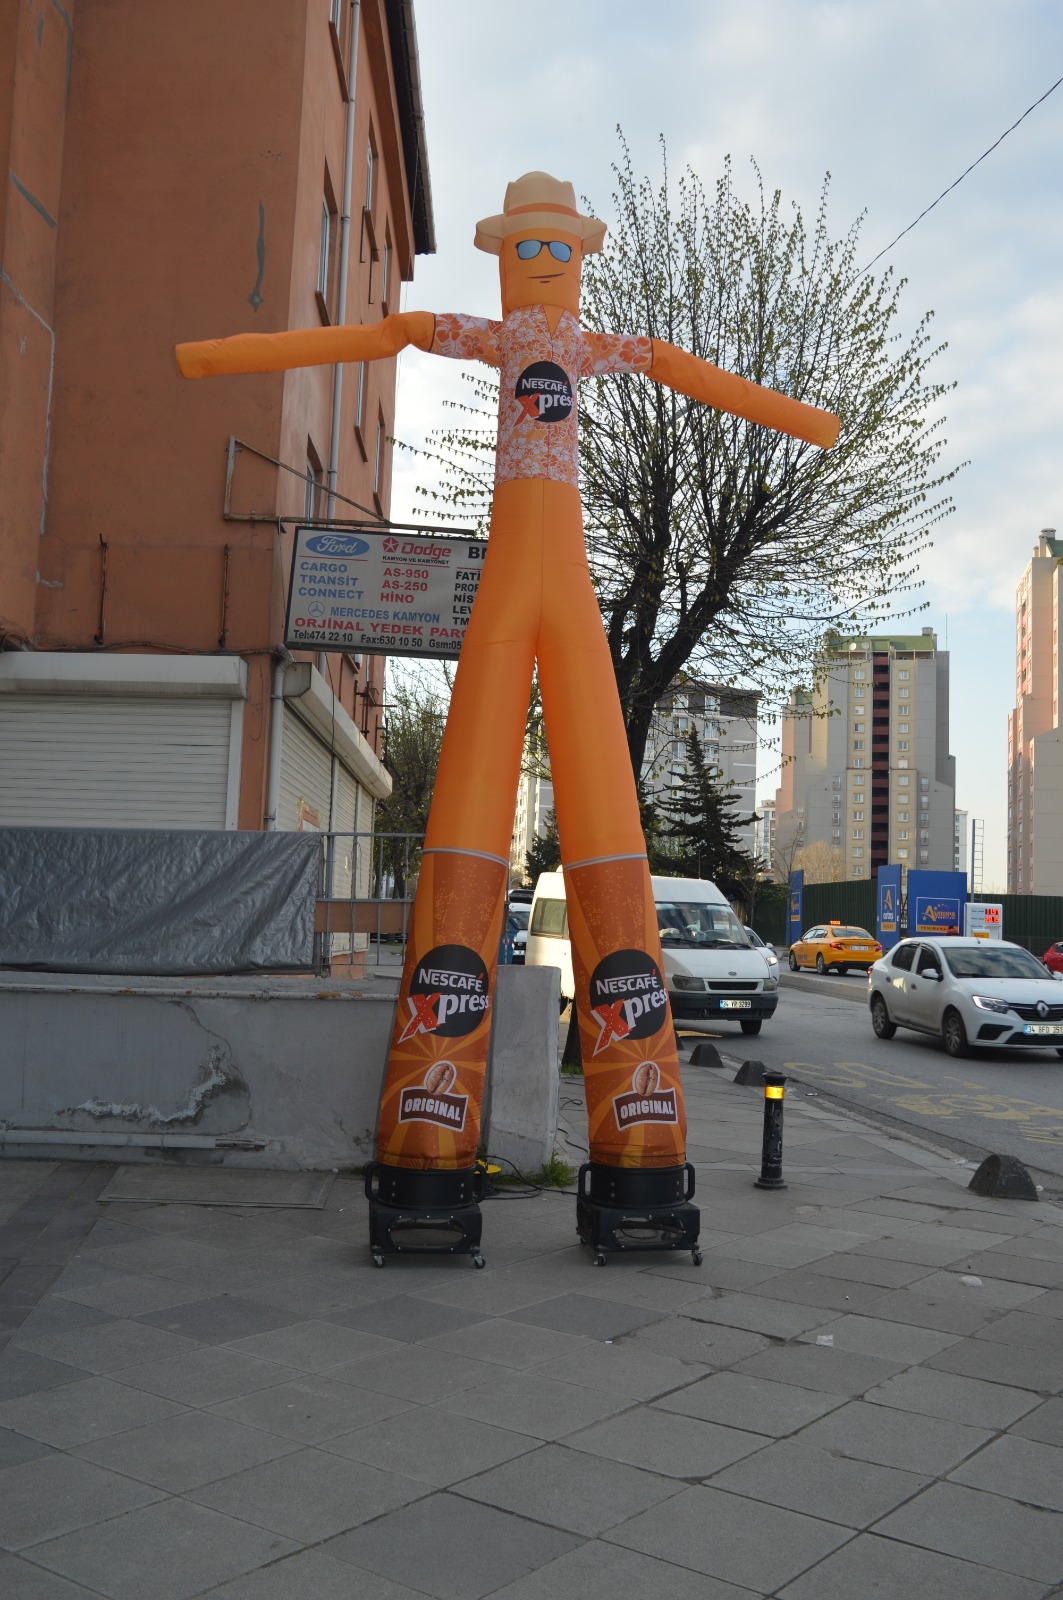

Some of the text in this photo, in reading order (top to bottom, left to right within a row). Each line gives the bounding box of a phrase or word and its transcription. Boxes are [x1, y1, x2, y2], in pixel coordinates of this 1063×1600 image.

[522, 378, 569, 393] NESCAFÉ
[317, 535, 356, 554] Ford
[402, 543, 451, 560] Dodge
[300, 562, 347, 573] CARGO
[383, 568, 429, 579] AS-950
[300, 574, 359, 586] TRANSİT
[382, 580, 428, 592] AS-250
[298, 587, 364, 600] CONNECT
[380, 592, 414, 604] HİNO
[331, 607, 440, 623] MERCEDES KAMYON
[295, 617, 364, 631] ORJİNAL
[370, 623, 423, 636] YEDEK
[294, 630, 326, 640] Tel:474
[328, 633, 339, 641] 22
[343, 633, 353, 642] 10
[361, 635, 395, 645] Fax:630
[400, 637, 409, 646] 10
[412, 637, 422, 647] 50
[419, 968, 483, 992] NESCAFÉ
[596, 969, 660, 996] NESCAFÉ
[404, 1098, 461, 1121] ORIGINAL
[620, 1100, 674, 1120] ORIGINAL
